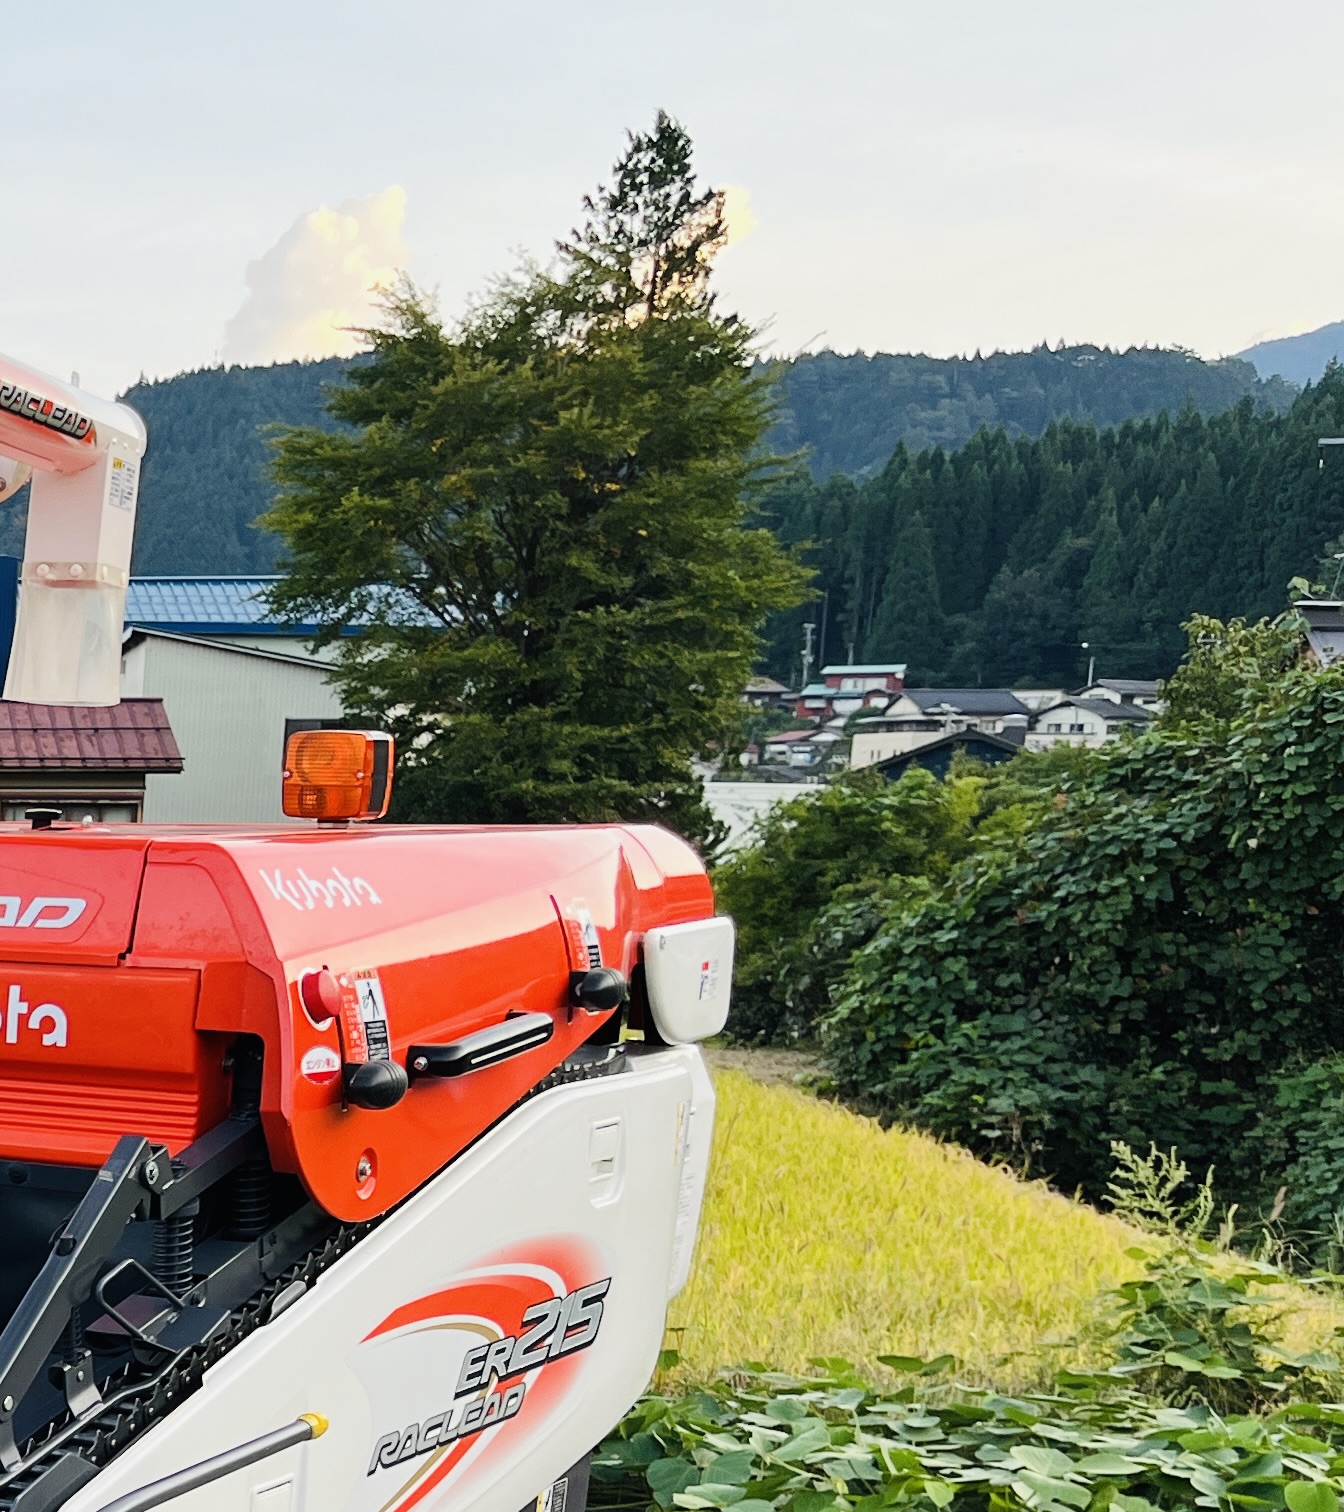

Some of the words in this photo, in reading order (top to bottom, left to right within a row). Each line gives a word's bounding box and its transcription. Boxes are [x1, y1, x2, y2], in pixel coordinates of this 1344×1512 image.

[258, 868, 382, 910] Kubota
[454, 1277, 612, 1398] ER215
[367, 1381, 526, 1477] RACLEAD
